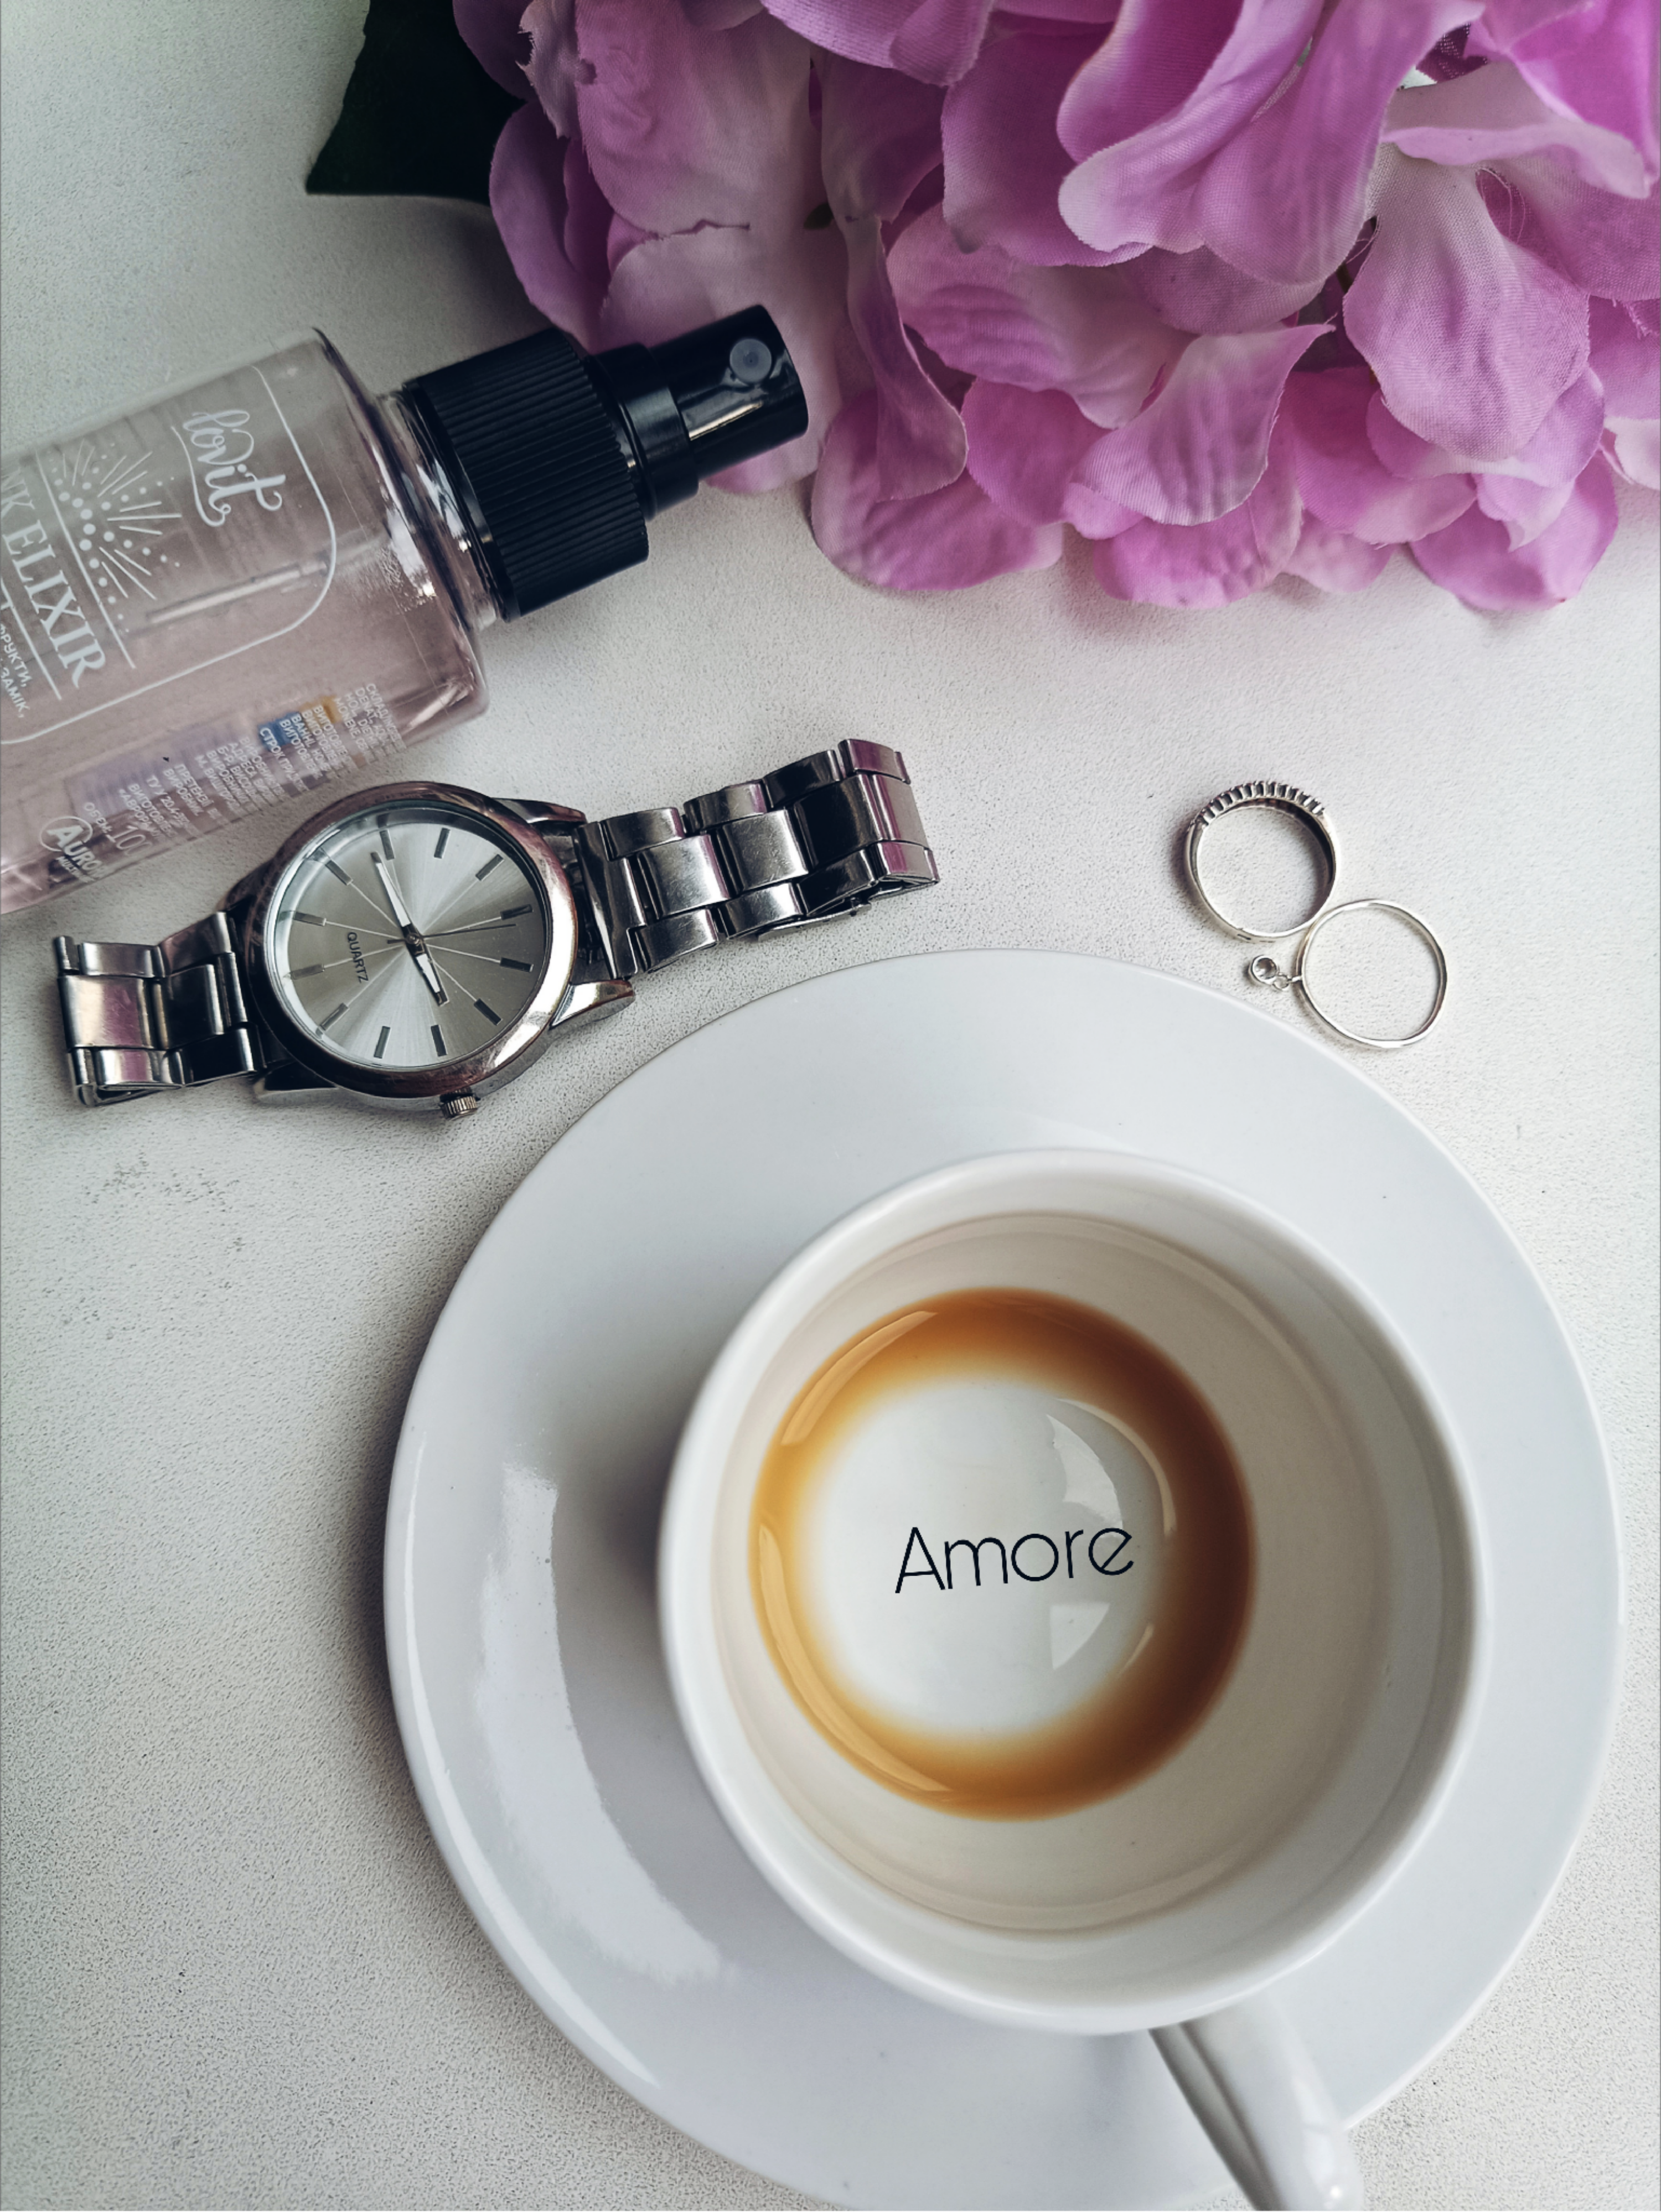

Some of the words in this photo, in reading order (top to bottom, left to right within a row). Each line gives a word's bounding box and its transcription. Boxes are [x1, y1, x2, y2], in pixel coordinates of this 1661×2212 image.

[171, 410, 286, 527] lovit
[2, 519, 106, 689] ELIXIR
[226, 740, 258, 779] АДРЕСА
[258, 726, 286, 760] СТРОК
[46, 825, 110, 880] AUROR
[346, 931, 369, 983] QUARTZ
[895, 1526, 1134, 1594] Amore
